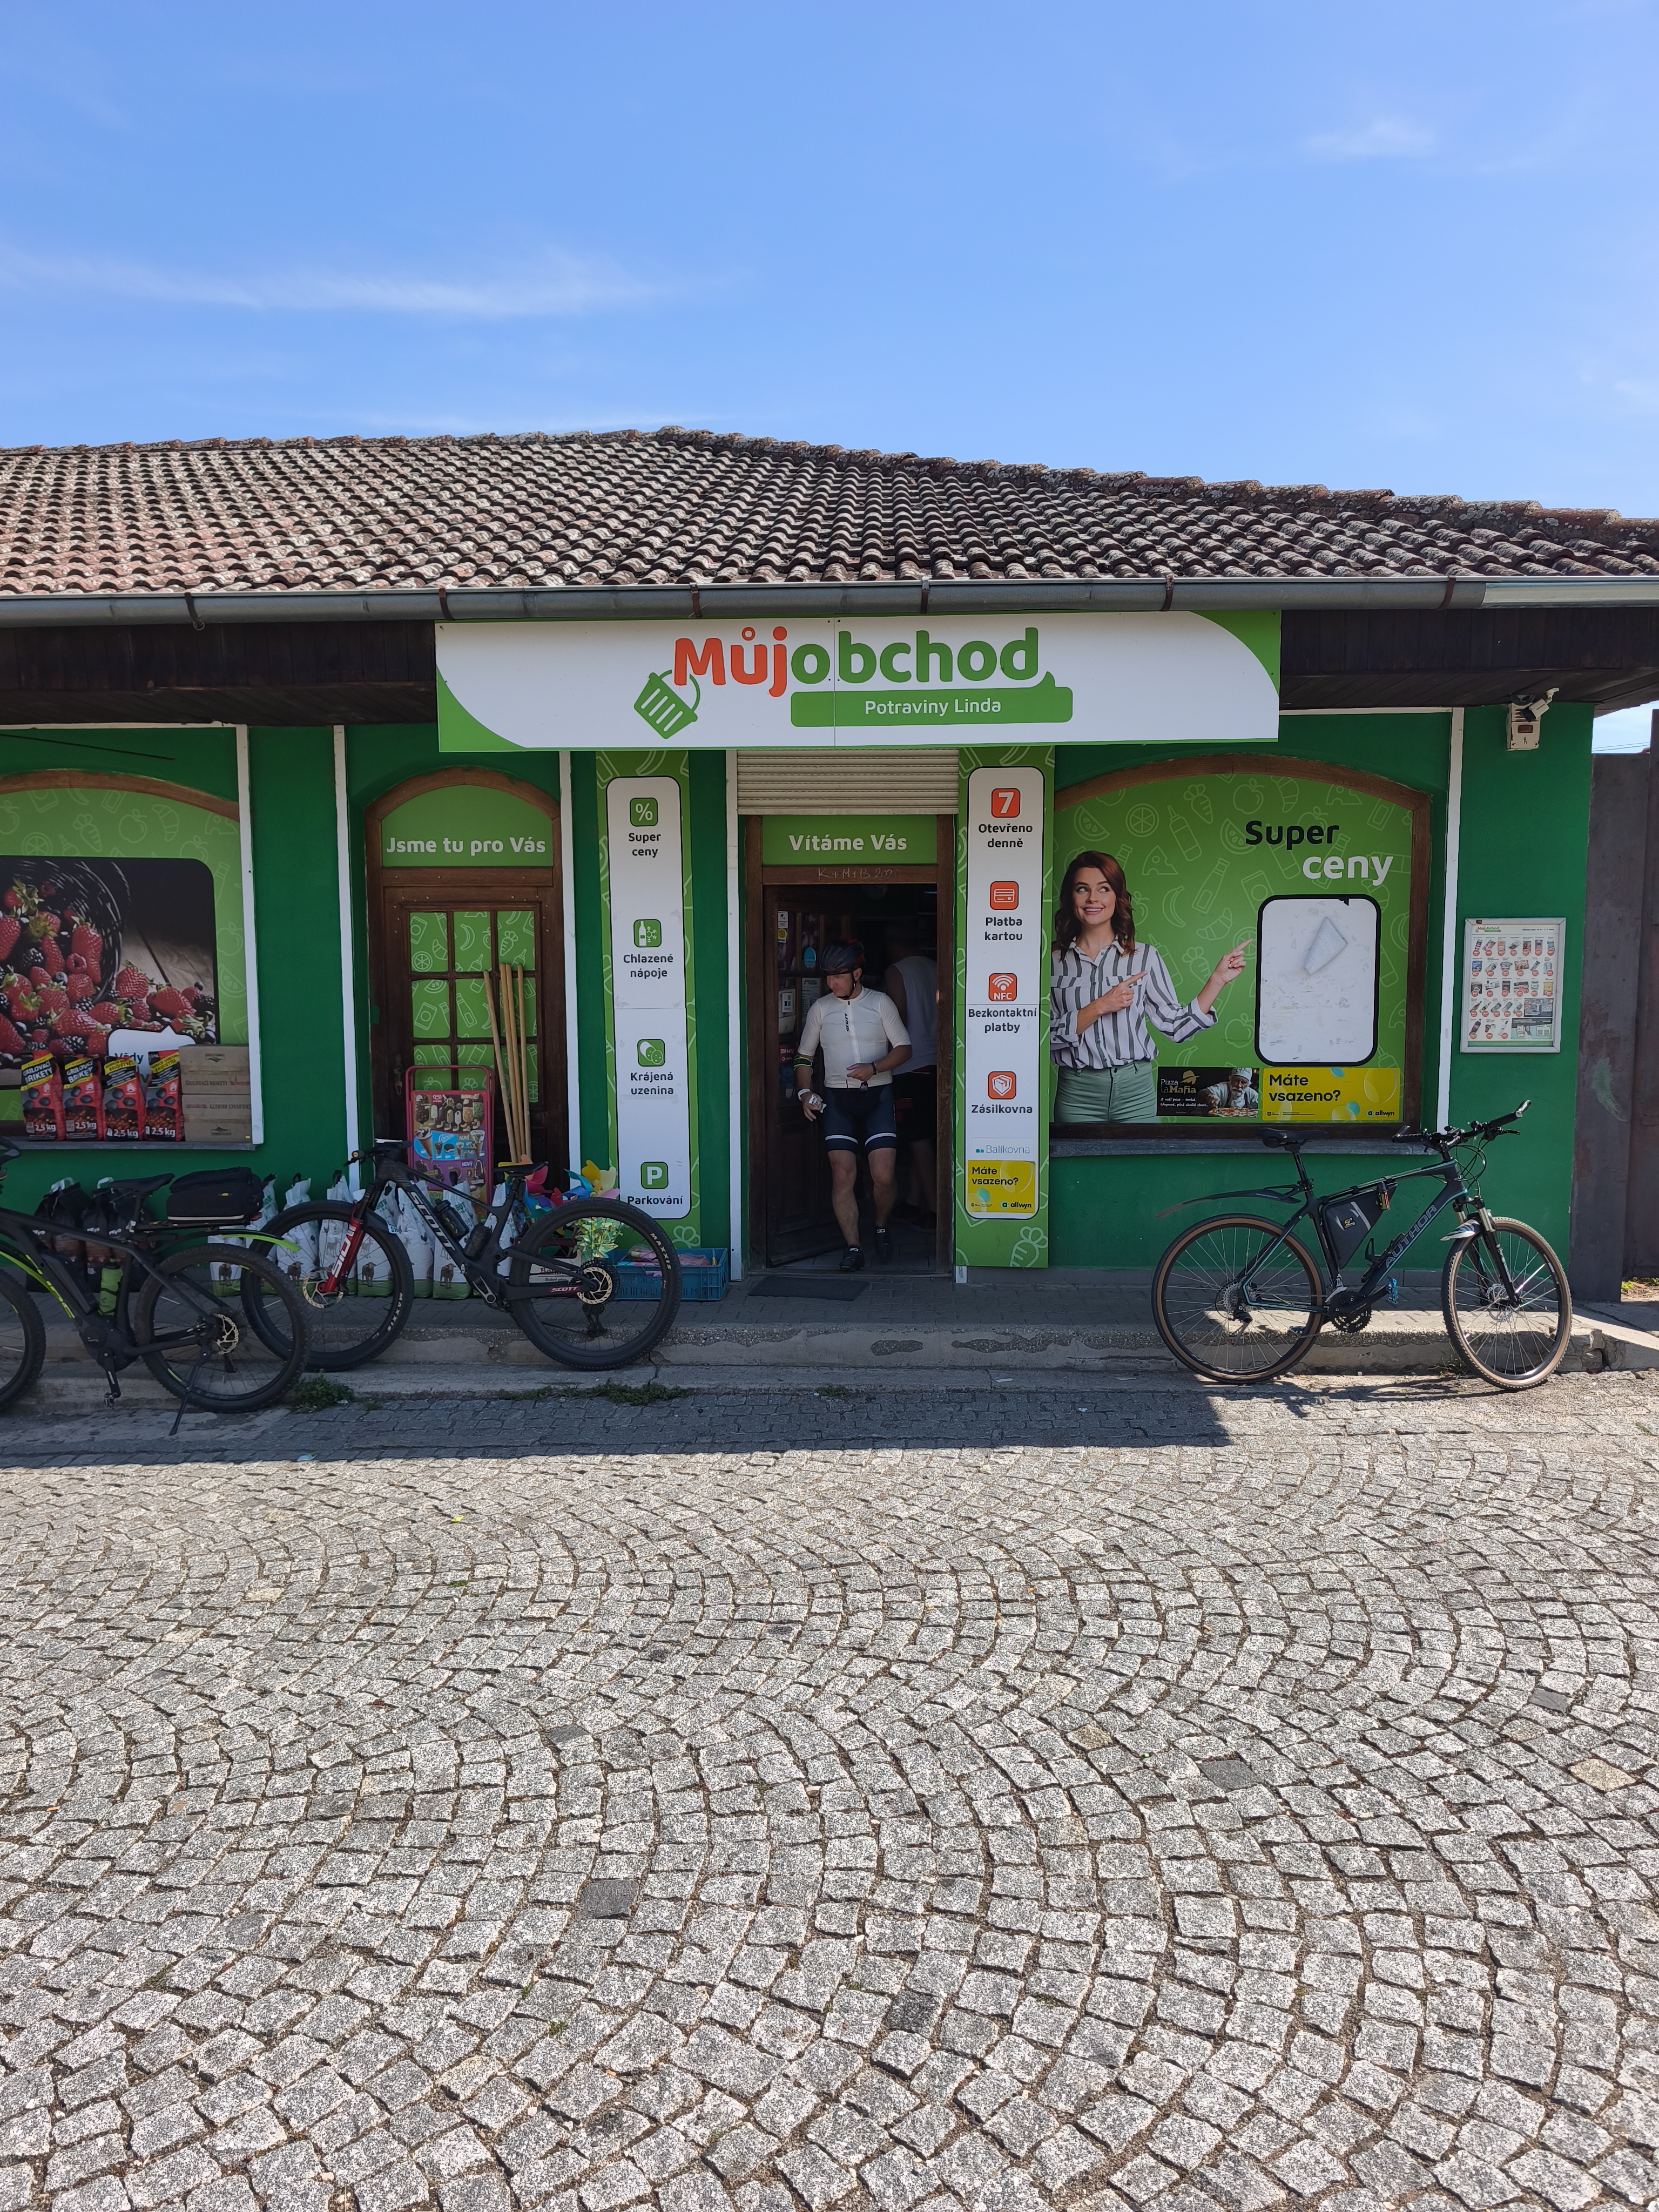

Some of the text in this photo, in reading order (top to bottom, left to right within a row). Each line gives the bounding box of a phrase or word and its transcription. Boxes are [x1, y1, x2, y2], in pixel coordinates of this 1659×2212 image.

[865, 697, 1001, 717] Potraviny Linda
[999, 792, 1015, 814] 7
[978, 823, 1033, 833] Otevřeno
[629, 832, 662, 844] Super
[1245, 820, 1340, 851] Super
[387, 837, 545, 857] Jsme tu pro Vás
[788, 834, 907, 851] Vítáme Vás
[987, 838, 1023, 848] denně
[632, 848, 658, 858] ceny
[1303, 855, 1394, 886] ceny
[986, 916, 1022, 926] Platba
[984, 931, 1023, 941] kartou
[623, 953, 673, 963] Chlazené
[630, 968, 667, 979] nápoje
[993, 993, 1013, 1001] NFC
[968, 1008, 1037, 1017] Bezkontaktní
[984, 1022, 1021, 1034] platby
[630, 1071, 673, 1083] Krájená
[1269, 1073, 1309, 1087] Máte
[631, 1085, 674, 1095] uzenina
[1269, 1089, 1341, 1102] vsazeno?
[971, 1103, 1033, 1114] Zásilkovna
[46, 1123, 56, 1132] kg
[86, 1121, 97, 1129] kg
[127, 1129, 139, 1138] kg
[165, 1127, 176, 1137] kg
[986, 1144, 1030, 1154] Balíkovna
[647, 1166, 663, 1185] P
[972, 1166, 997, 1175] Máte
[972, 1177, 1019, 1185] vsazeno?
[626, 1195, 683, 1205] Parkování
[1010, 1201, 1032, 1210] allwyn
[410, 1191, 456, 1251] SCOTT
[1385, 1205, 1437, 1269] AUTHOR
[650, 1233, 672, 1270] MAXXIS
[387, 1292, 403, 1332] MAXXIS
